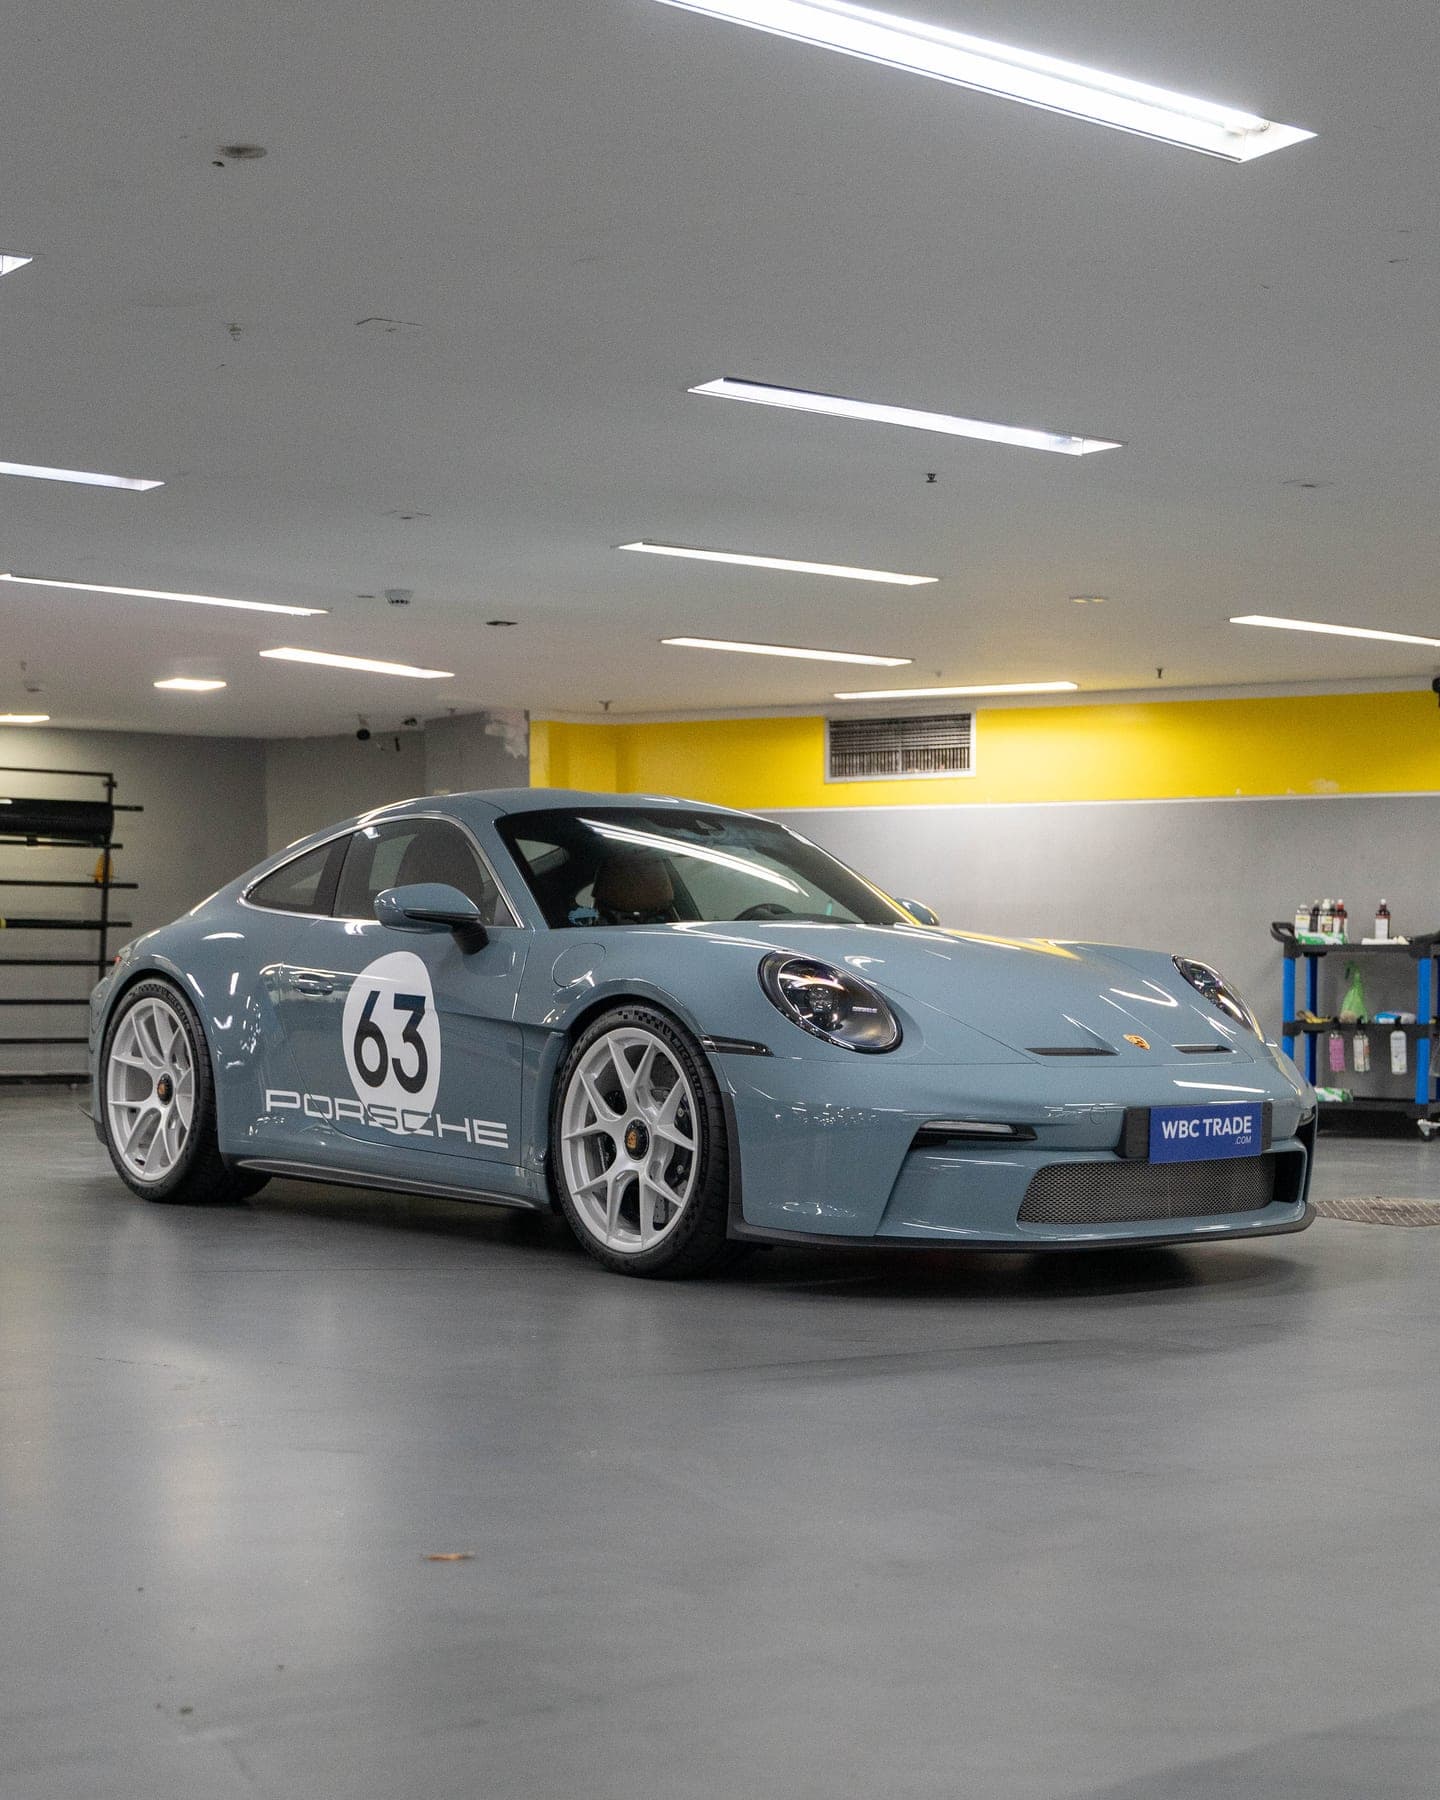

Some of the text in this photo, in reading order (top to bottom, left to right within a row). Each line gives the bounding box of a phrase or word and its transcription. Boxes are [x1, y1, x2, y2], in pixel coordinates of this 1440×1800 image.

[353, 990, 428, 1094] 63
[265, 1089, 509, 1149] PORSCHE
[1161, 1115, 1253, 1139] WBC TRADE
[1234, 1135, 1252, 1145] .COM
